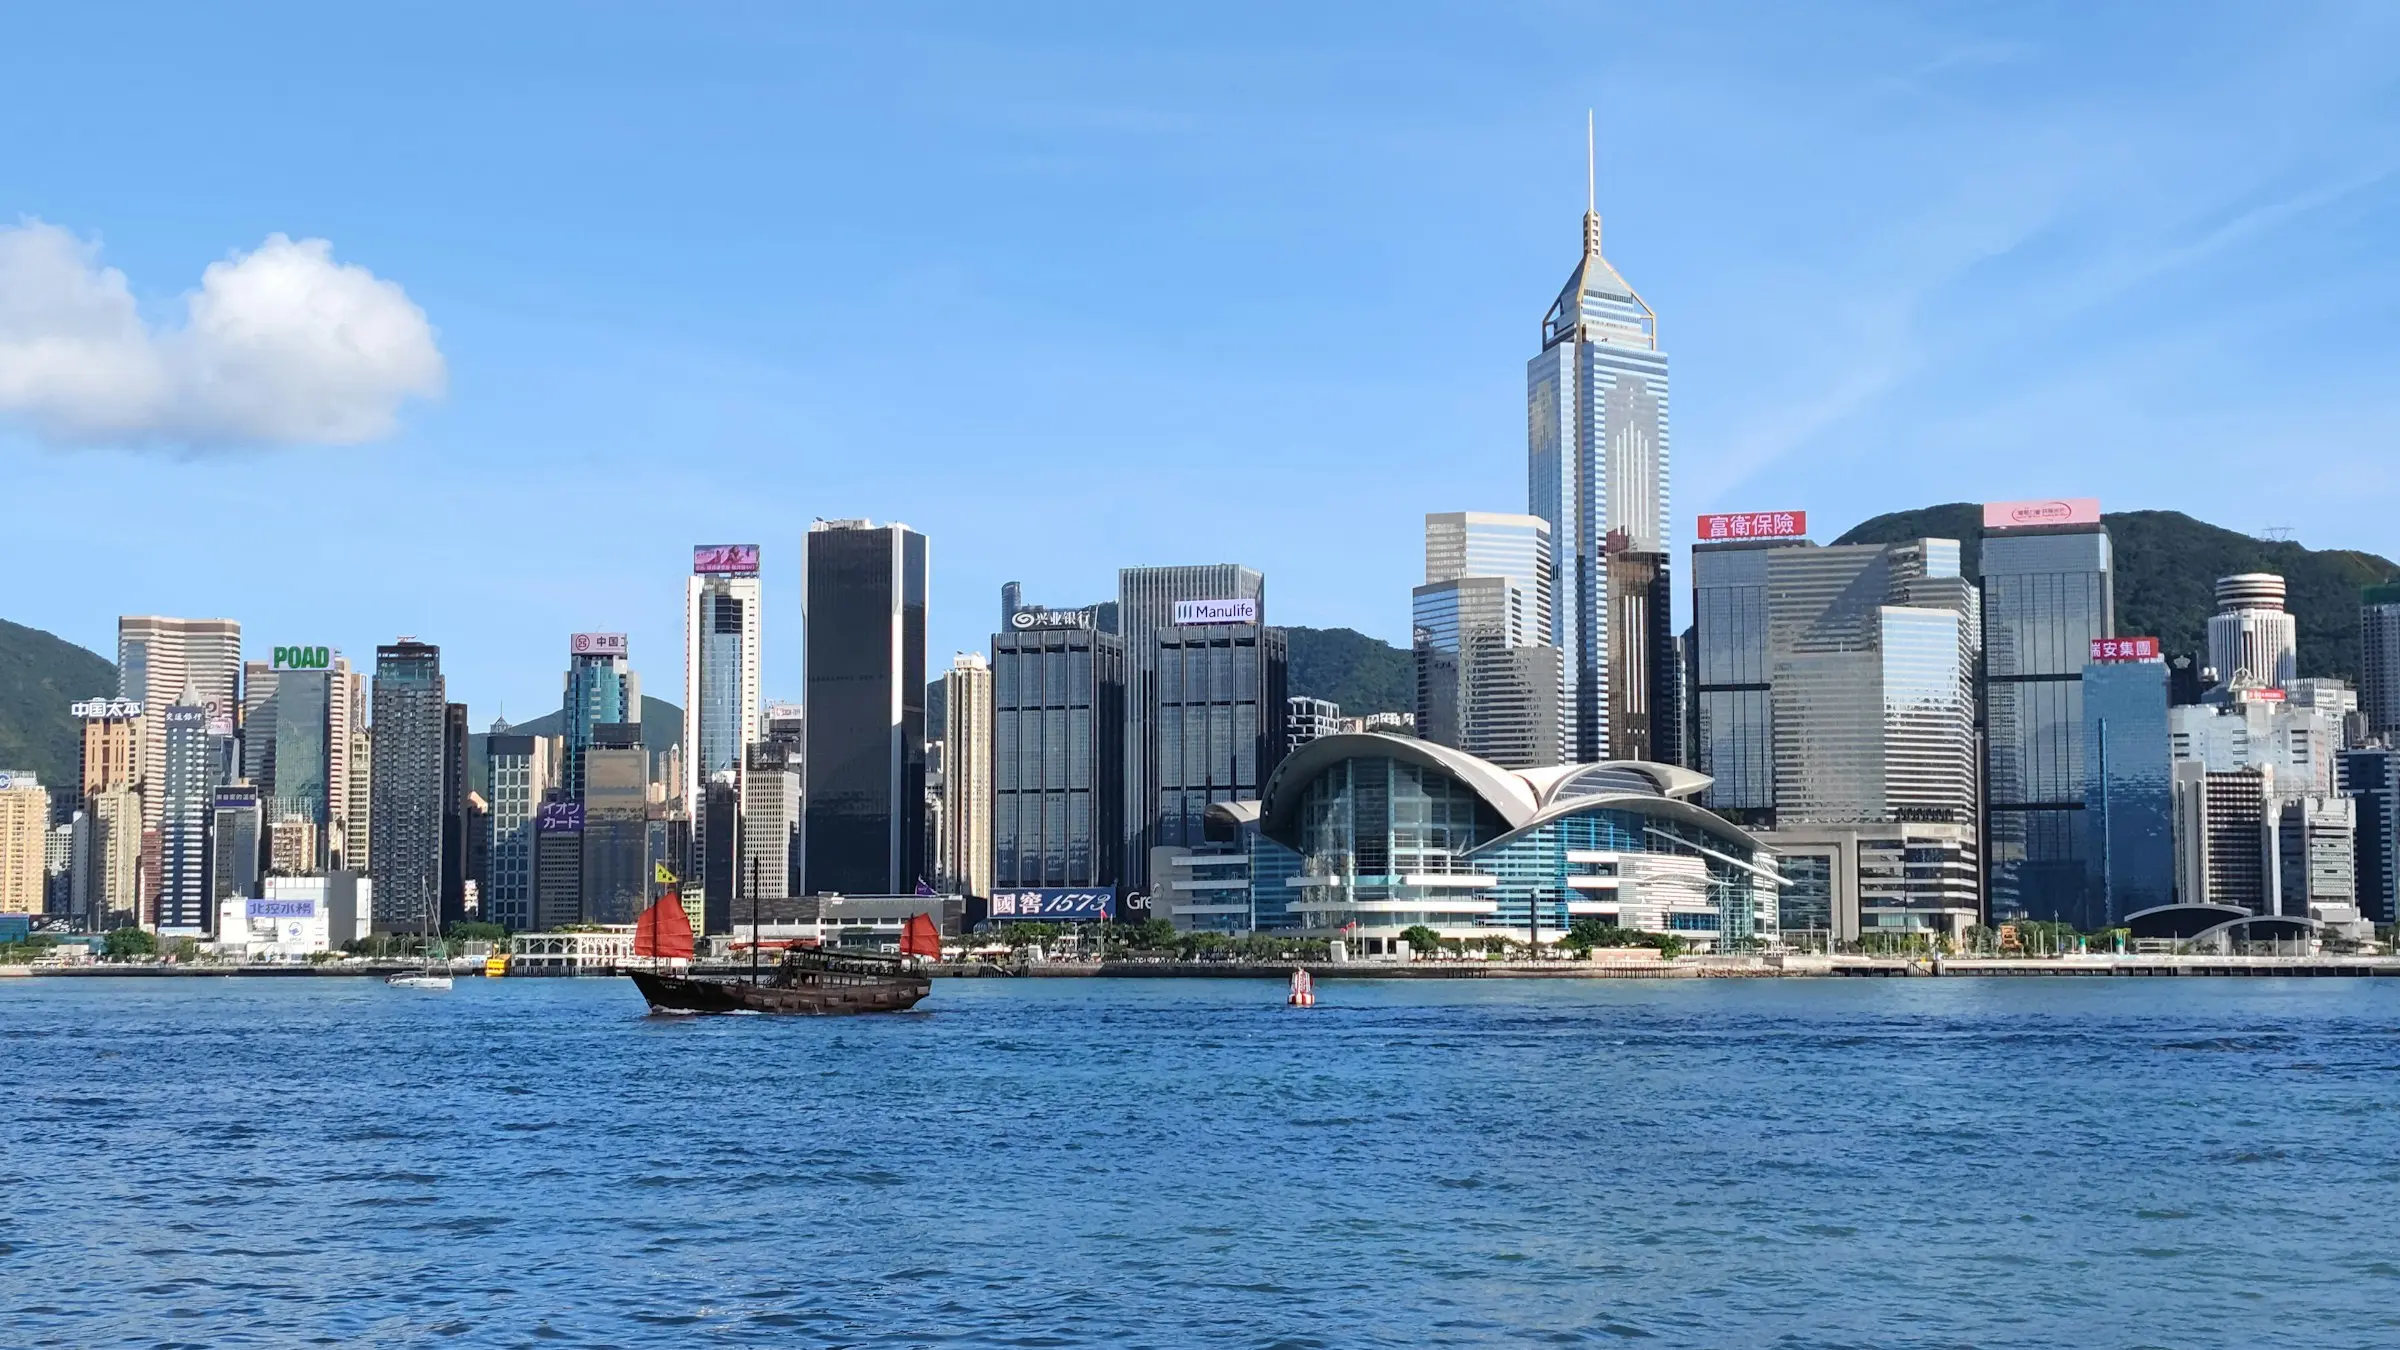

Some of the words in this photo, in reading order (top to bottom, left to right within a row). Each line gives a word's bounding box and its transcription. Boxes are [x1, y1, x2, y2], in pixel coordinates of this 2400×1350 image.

[1709, 513, 1795, 537] 富衛保險
[1196, 603, 1253, 618] Manulife
[1035, 610, 1091, 629] 兴业银行
[273, 646, 329, 669] POAD
[71, 702, 141, 717] 中国太平
[543, 802, 580, 815] イオン
[543, 816, 580, 829] カード
[250, 903, 311, 915] 北控水務
